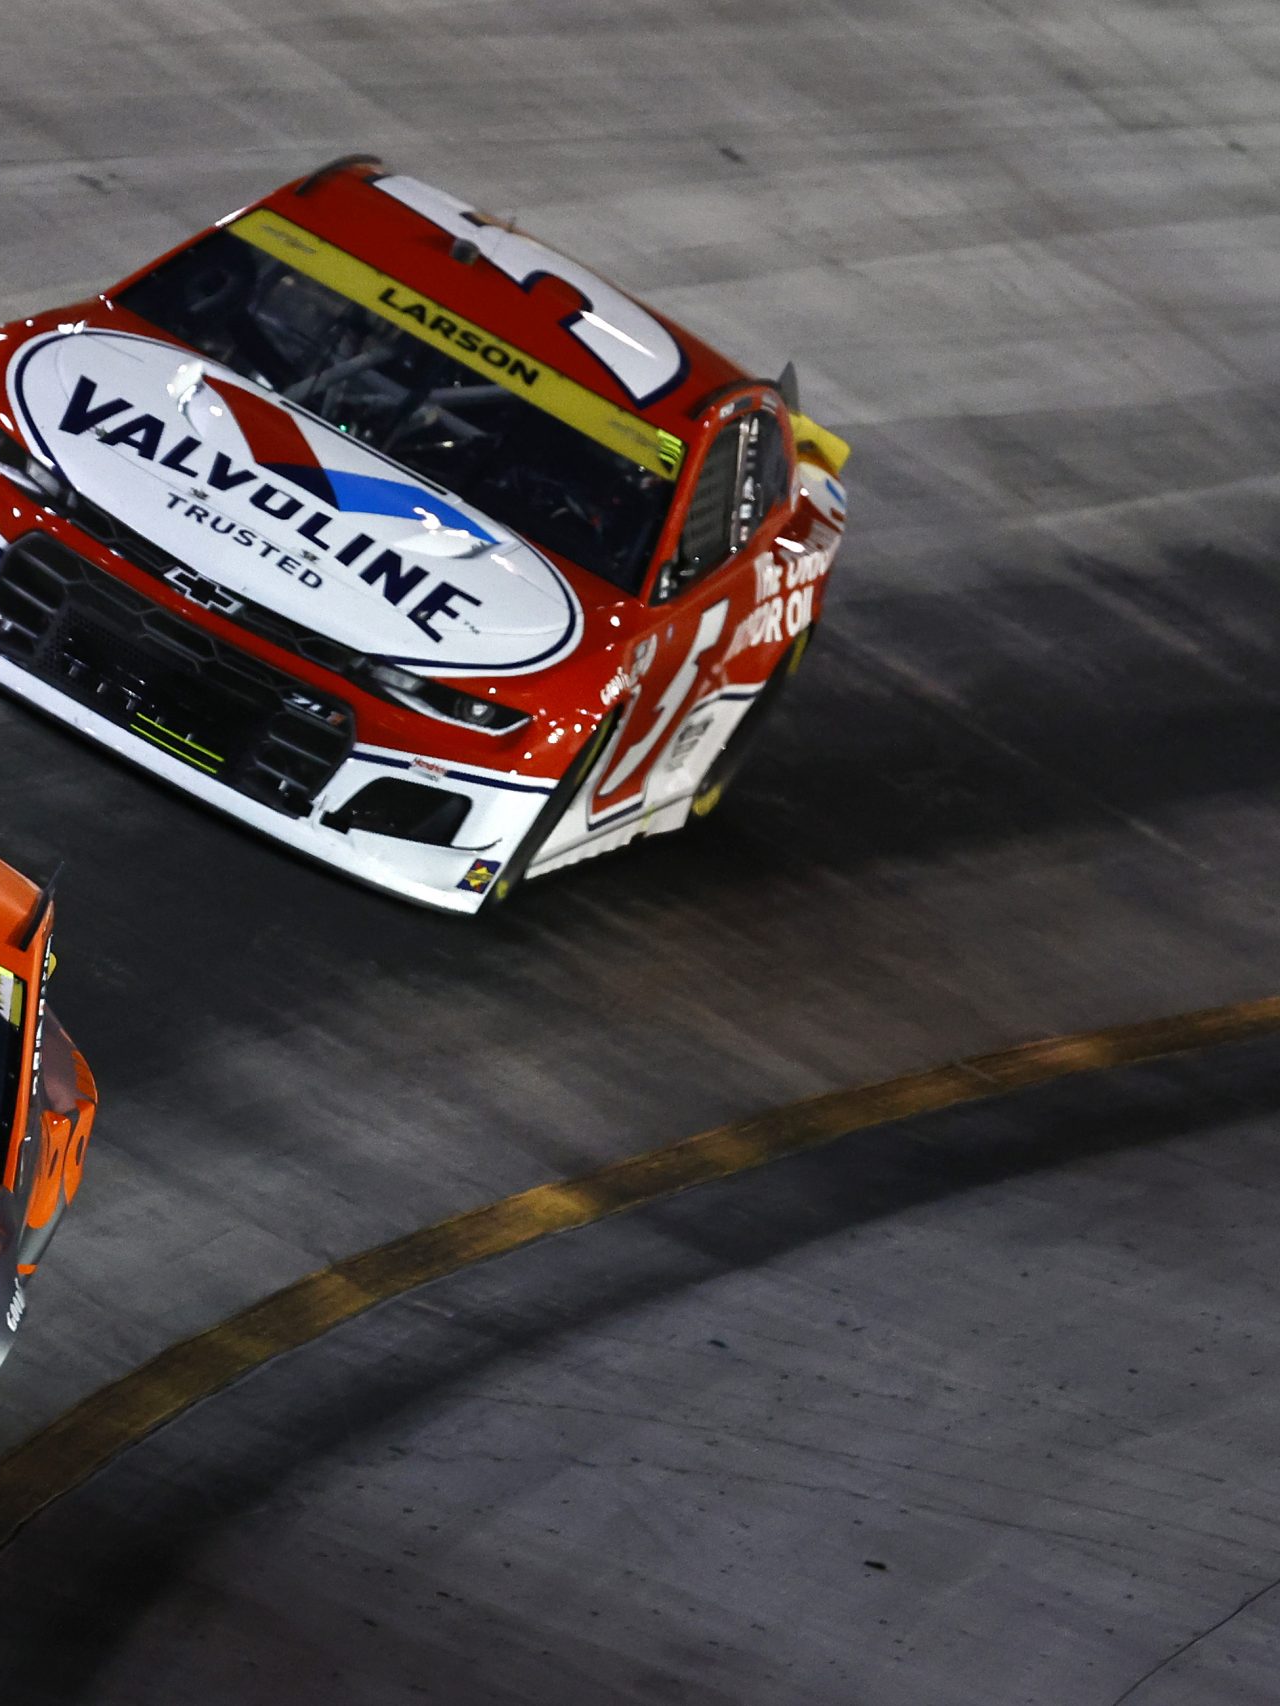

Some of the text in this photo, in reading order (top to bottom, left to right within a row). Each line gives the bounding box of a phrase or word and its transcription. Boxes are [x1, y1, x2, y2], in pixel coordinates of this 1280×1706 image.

[378, 287, 540, 386] LARSON
[59, 374, 482, 643] VALVOLINE
[166, 491, 322, 590] TRUSTED
